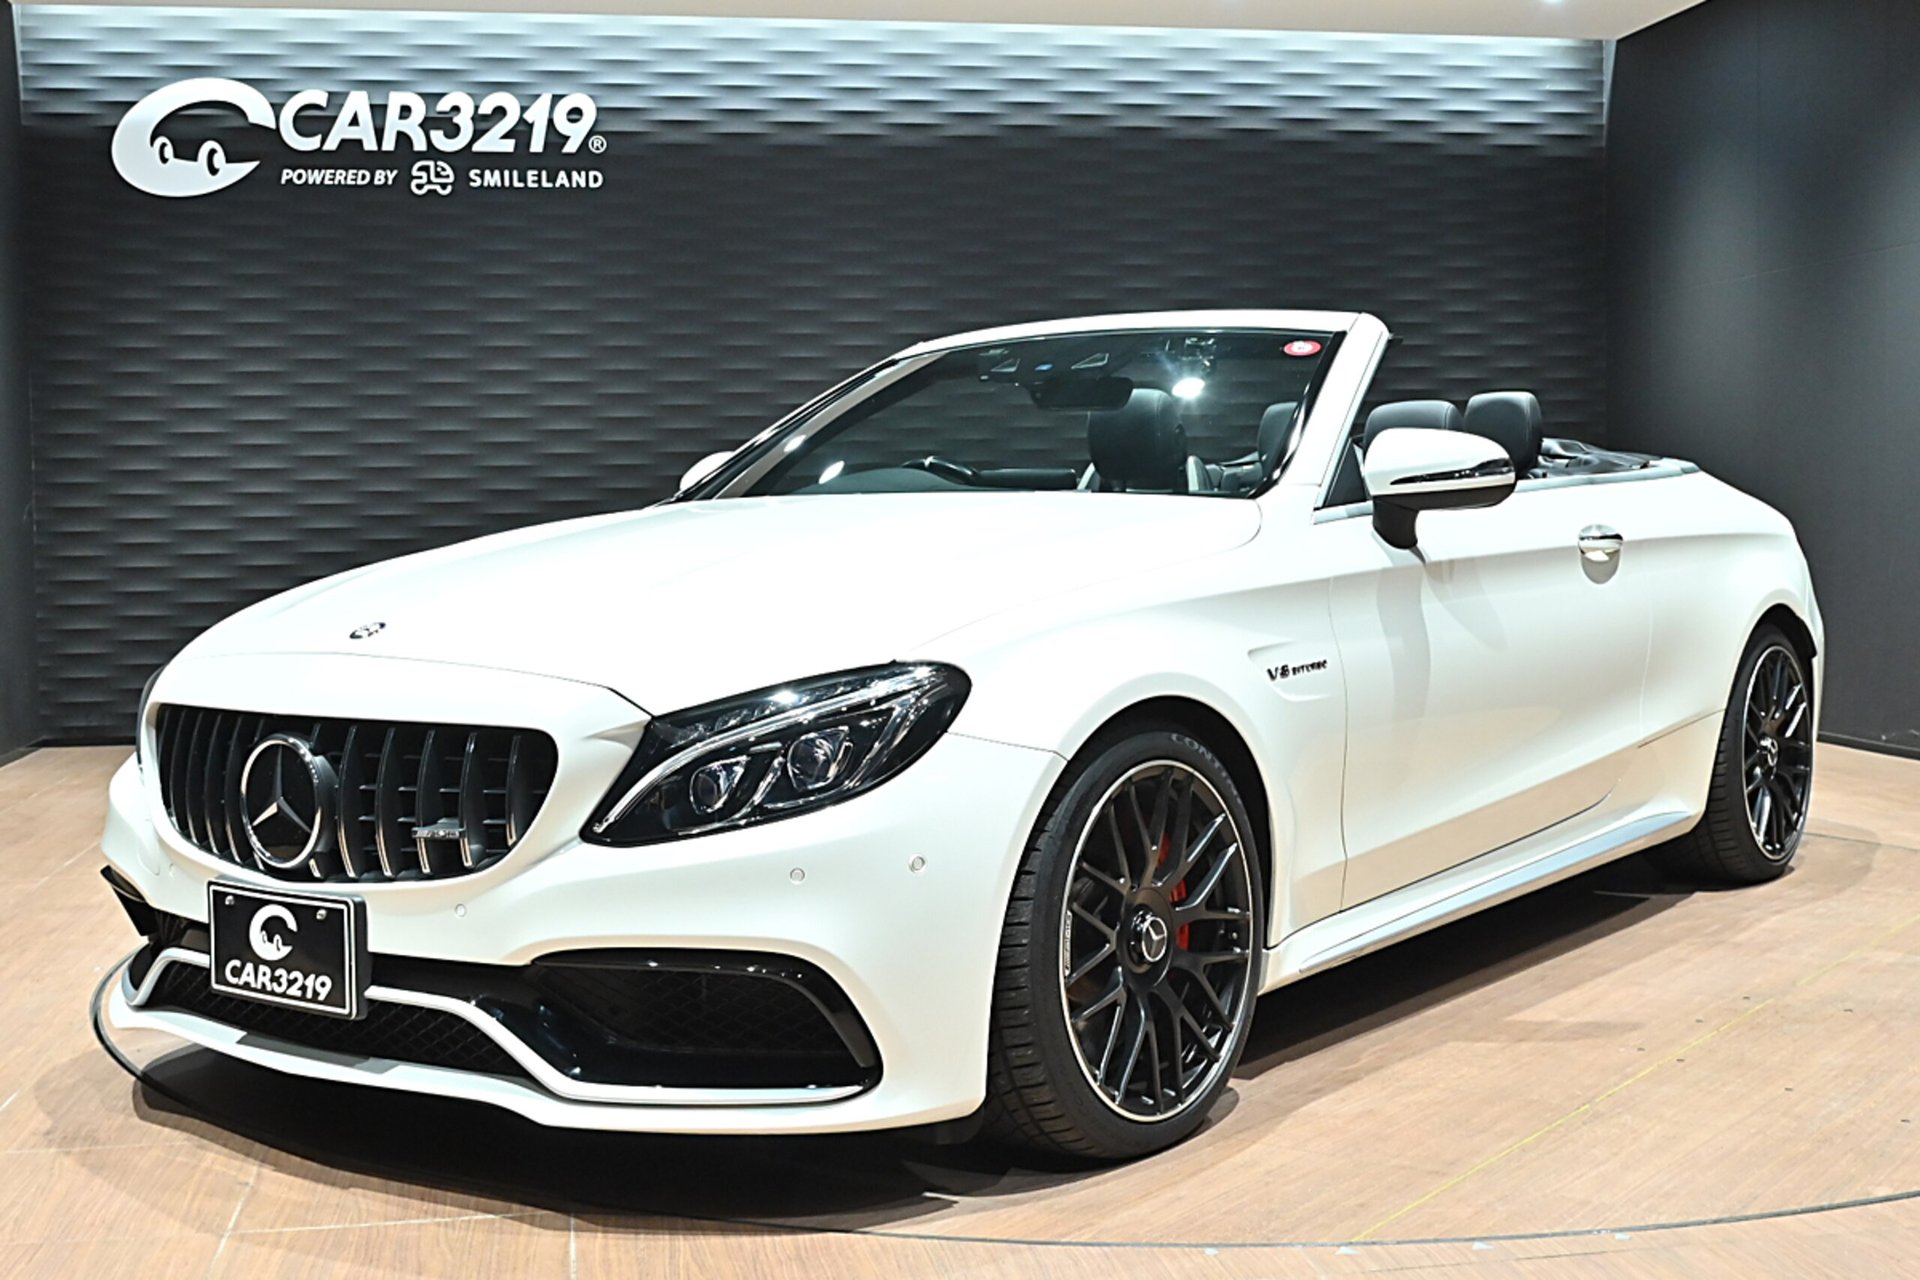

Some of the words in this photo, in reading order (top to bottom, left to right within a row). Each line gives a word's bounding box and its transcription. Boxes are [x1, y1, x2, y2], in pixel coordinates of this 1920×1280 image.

[281, 168, 371, 185] POWERED
[374, 169, 398, 185] BY
[469, 168, 603, 188] SMILELAND
[225, 959, 332, 1001] CAR3219
